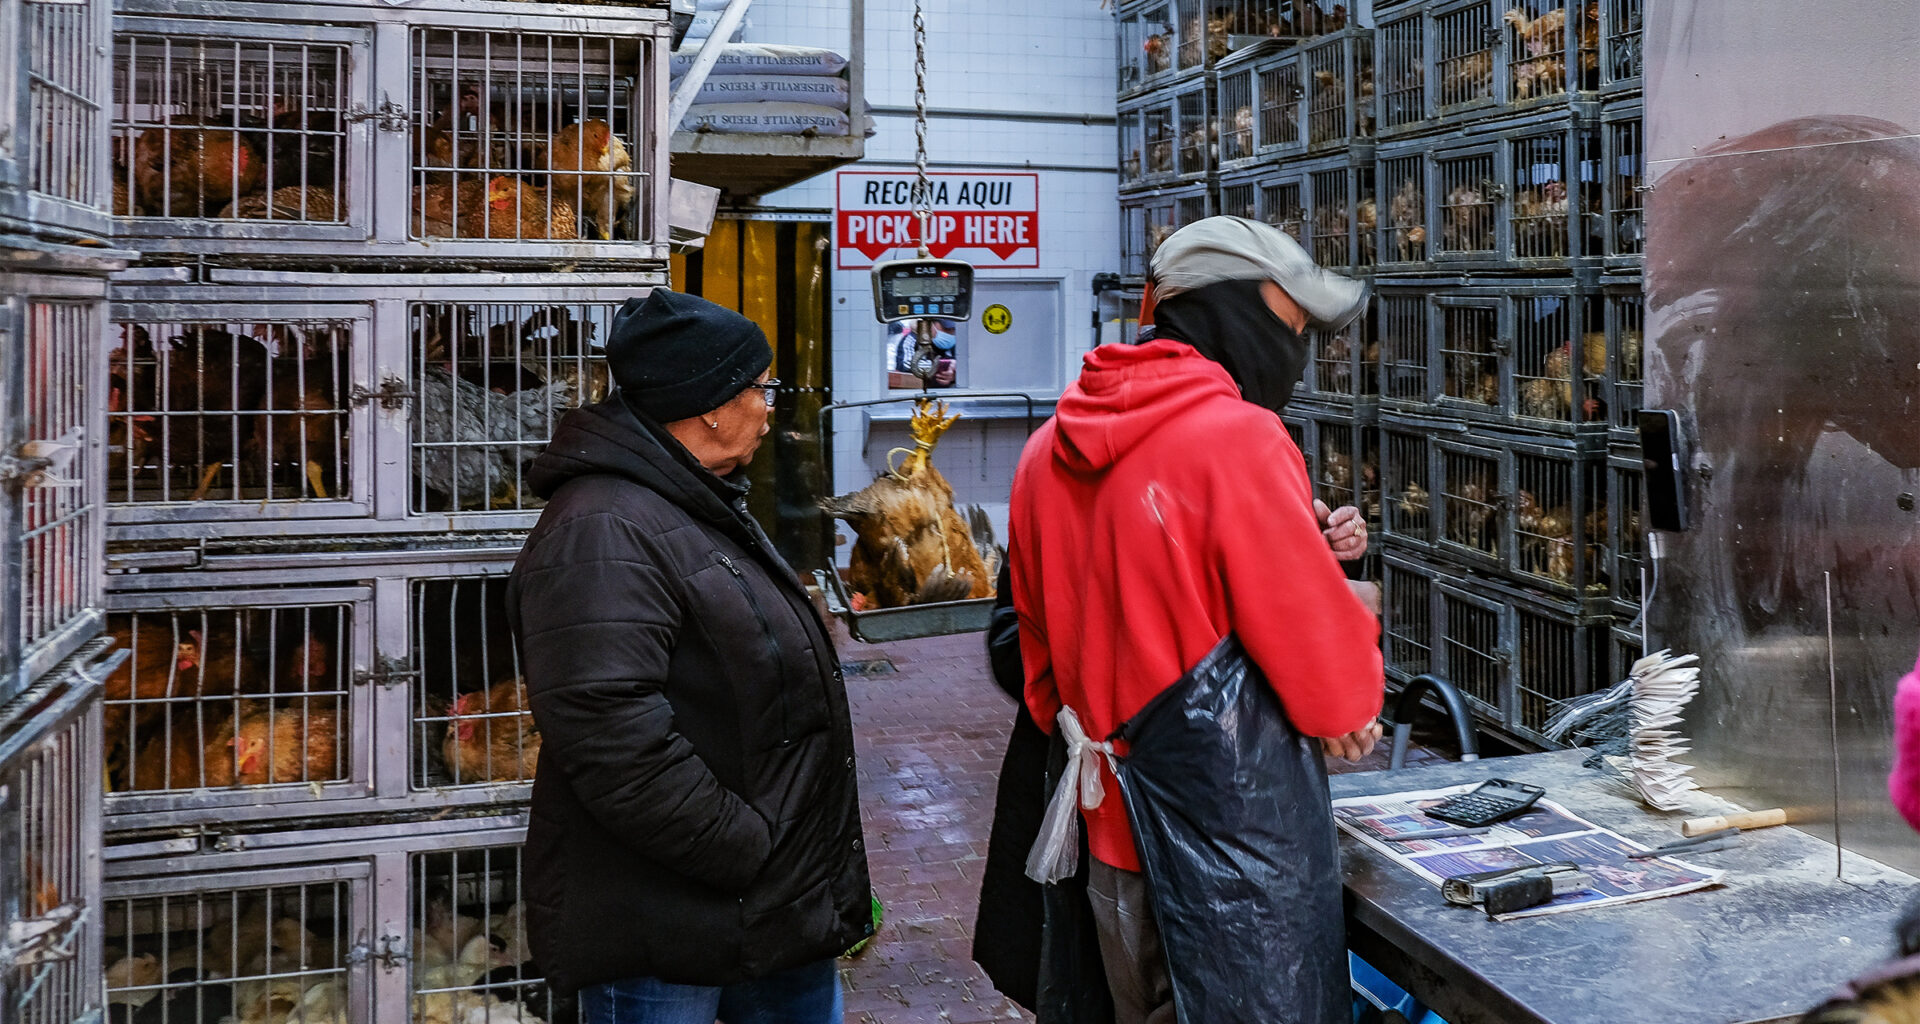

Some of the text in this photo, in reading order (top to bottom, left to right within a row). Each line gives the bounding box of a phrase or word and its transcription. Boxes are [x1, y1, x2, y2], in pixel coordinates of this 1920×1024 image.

[715, 55, 741, 65] FEE
[746, 55, 822, 65] MEISERVILLE
[719, 81, 757, 92] FEEDS
[761, 81, 836, 93] MEISERVILLE
[696, 114, 837, 127] MEISERVILLE FEEDS LLC
[956, 181, 1013, 209] AQUI
[848, 214, 1030, 244] PICK UP HERE
[915, 266, 937, 275] CAS
